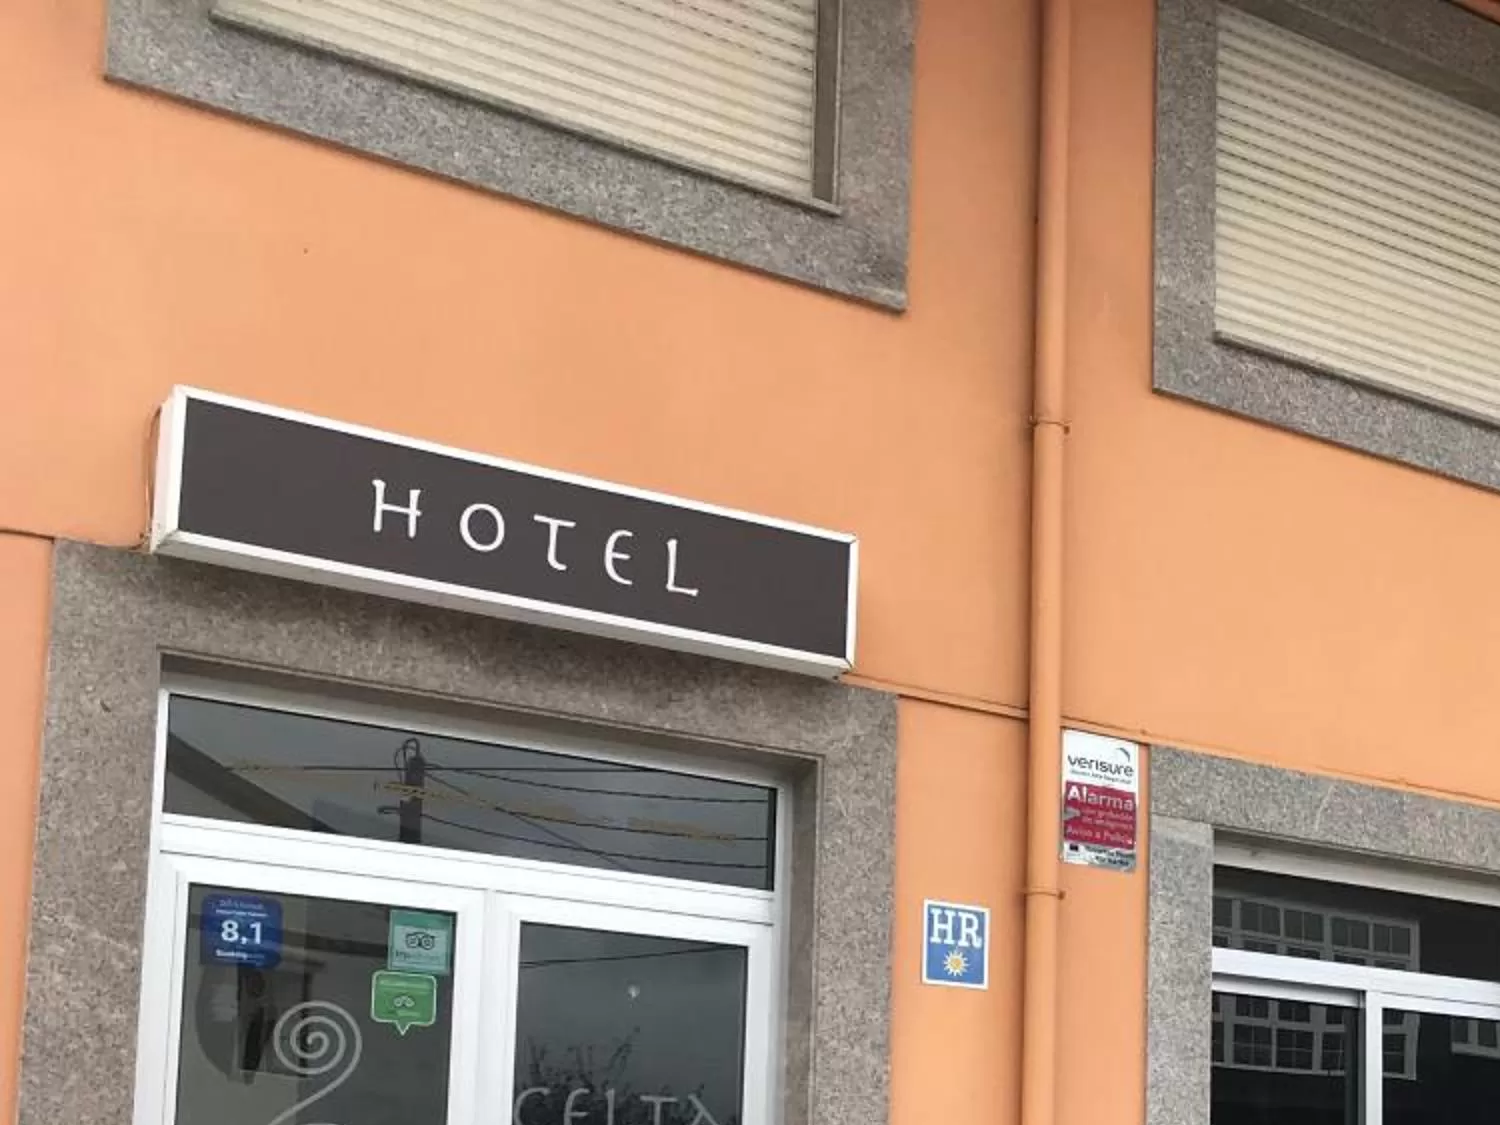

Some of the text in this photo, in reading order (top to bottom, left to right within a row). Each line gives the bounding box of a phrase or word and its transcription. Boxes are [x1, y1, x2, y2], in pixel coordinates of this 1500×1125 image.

[372, 479, 698, 597] HOTEL
[1067, 755, 1134, 778] verisure
[1067, 785, 1134, 811] Alarma
[930, 908, 982, 948] HR
